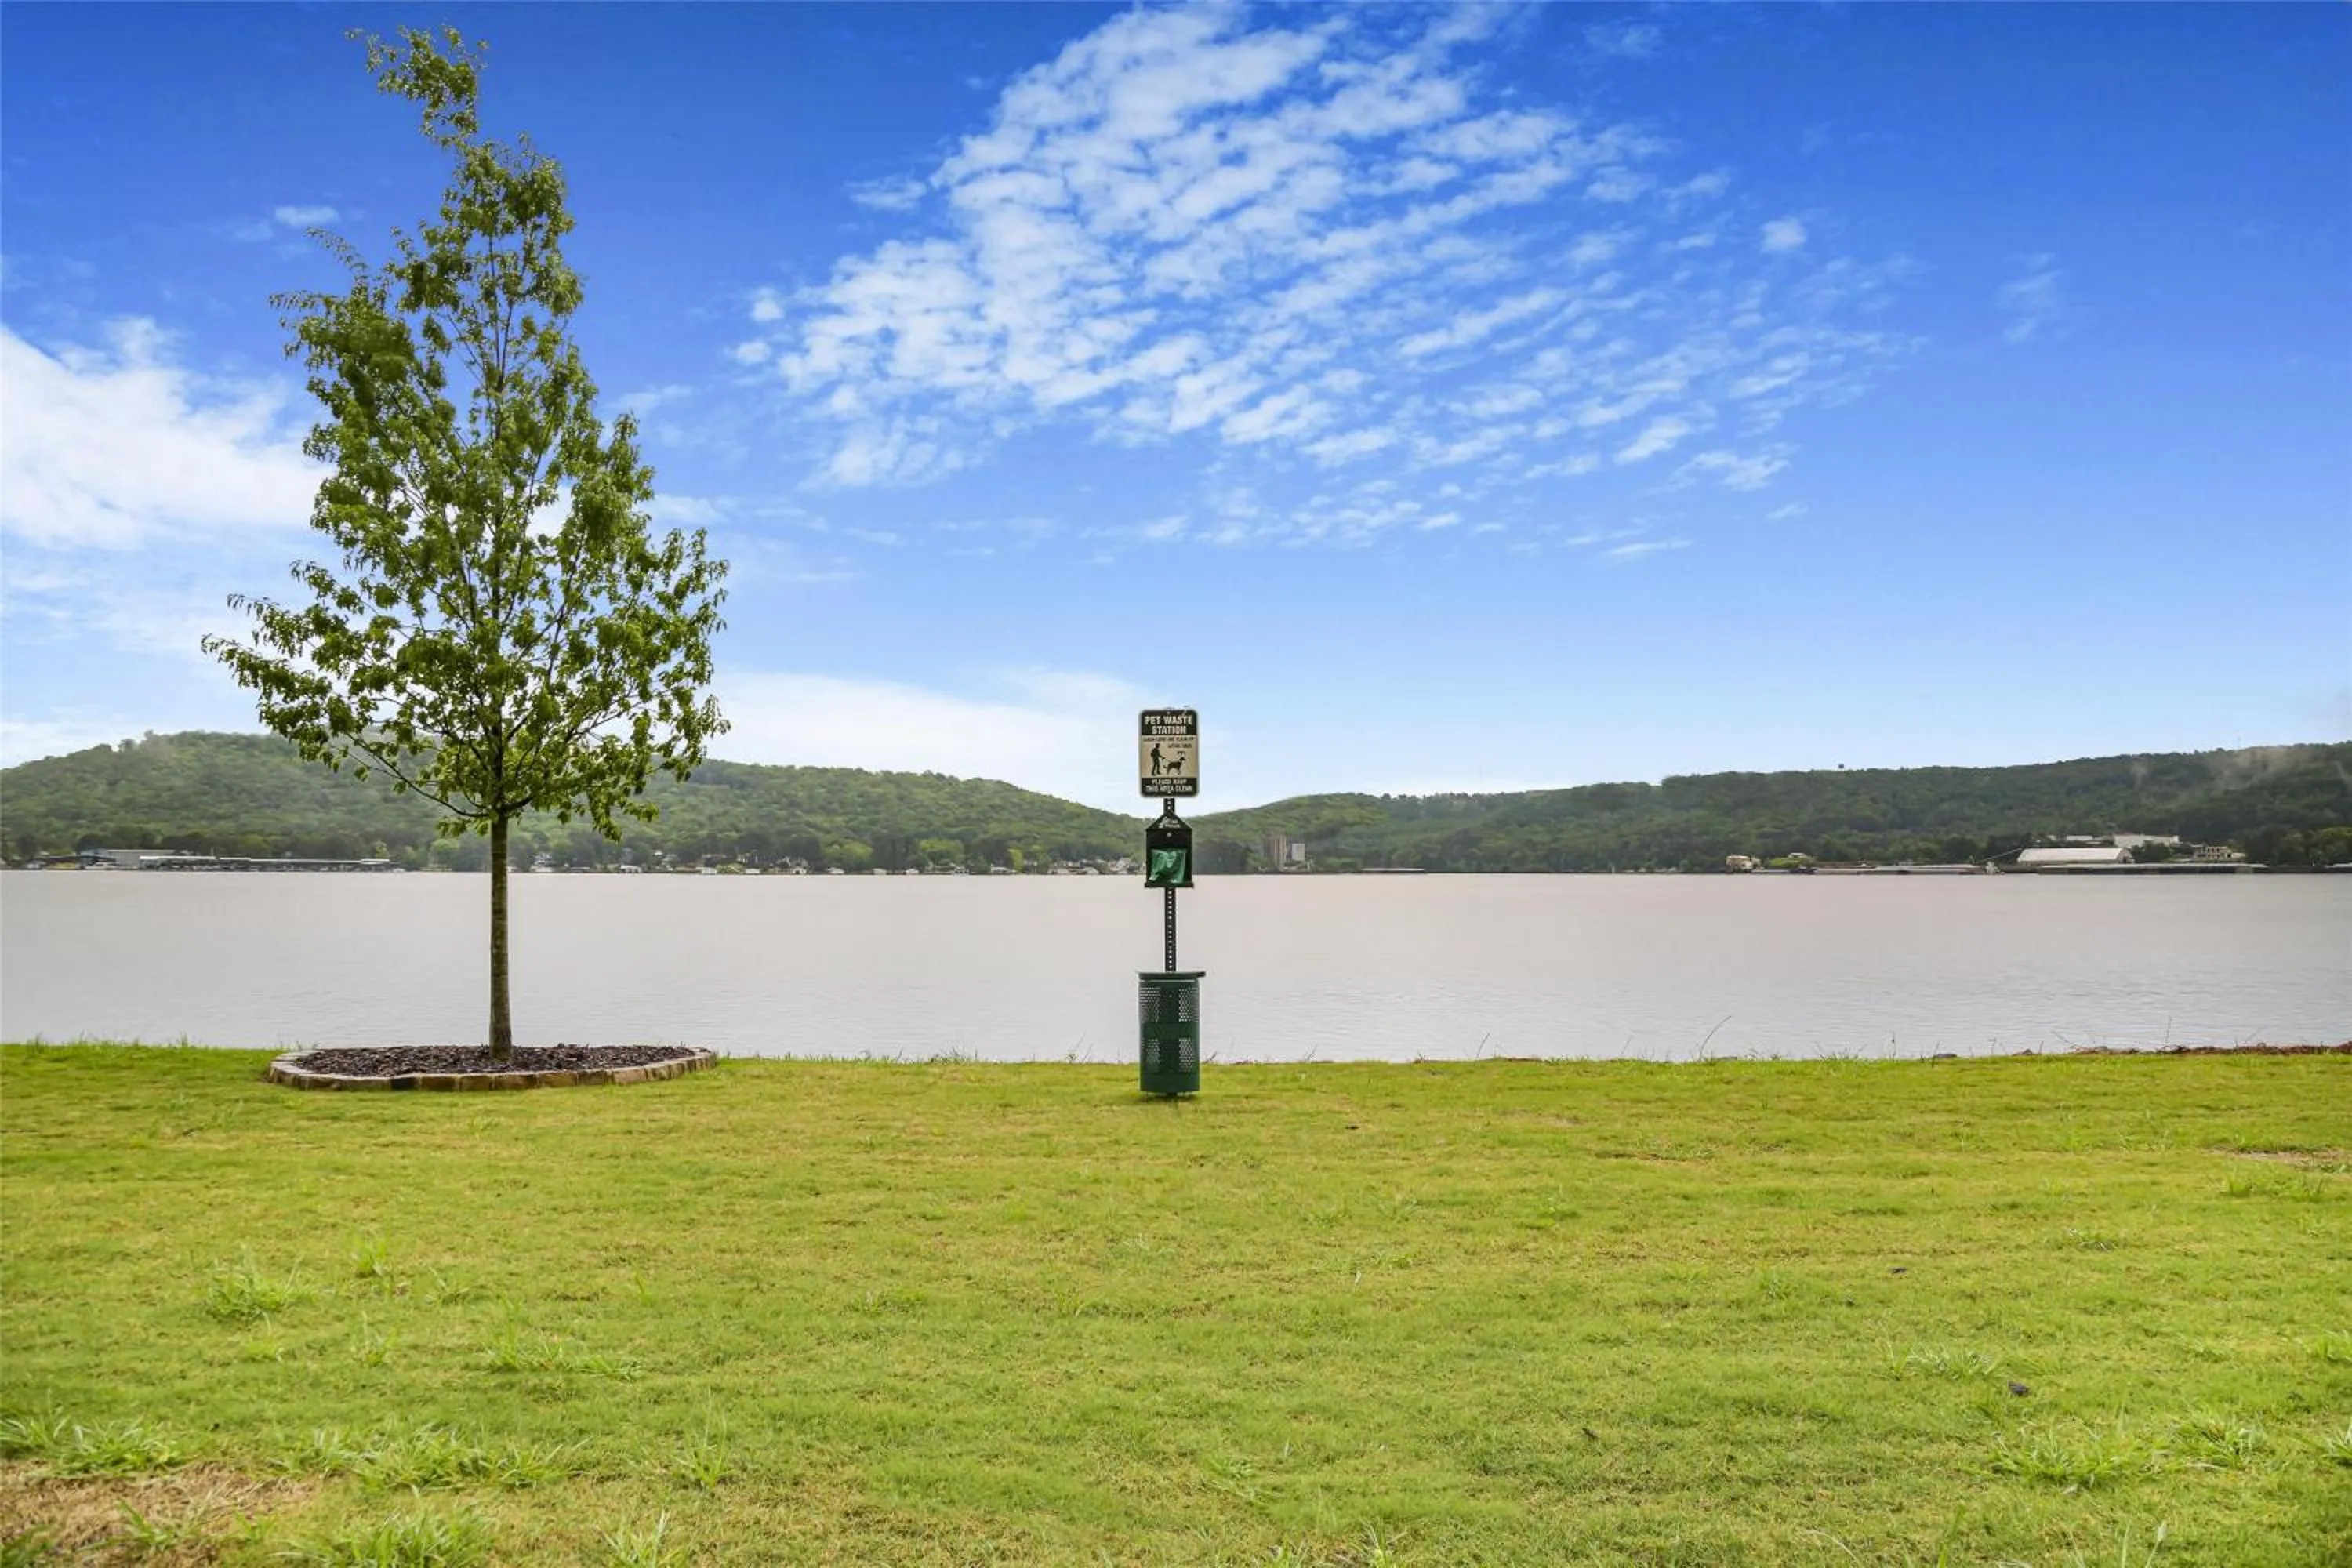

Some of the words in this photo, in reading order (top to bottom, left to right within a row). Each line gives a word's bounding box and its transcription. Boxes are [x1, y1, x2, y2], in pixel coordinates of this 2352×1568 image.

[1145, 716, 1160, 725] PET
[1163, 716, 1192, 725] WASTE
[1152, 725, 1186, 735] STATION
